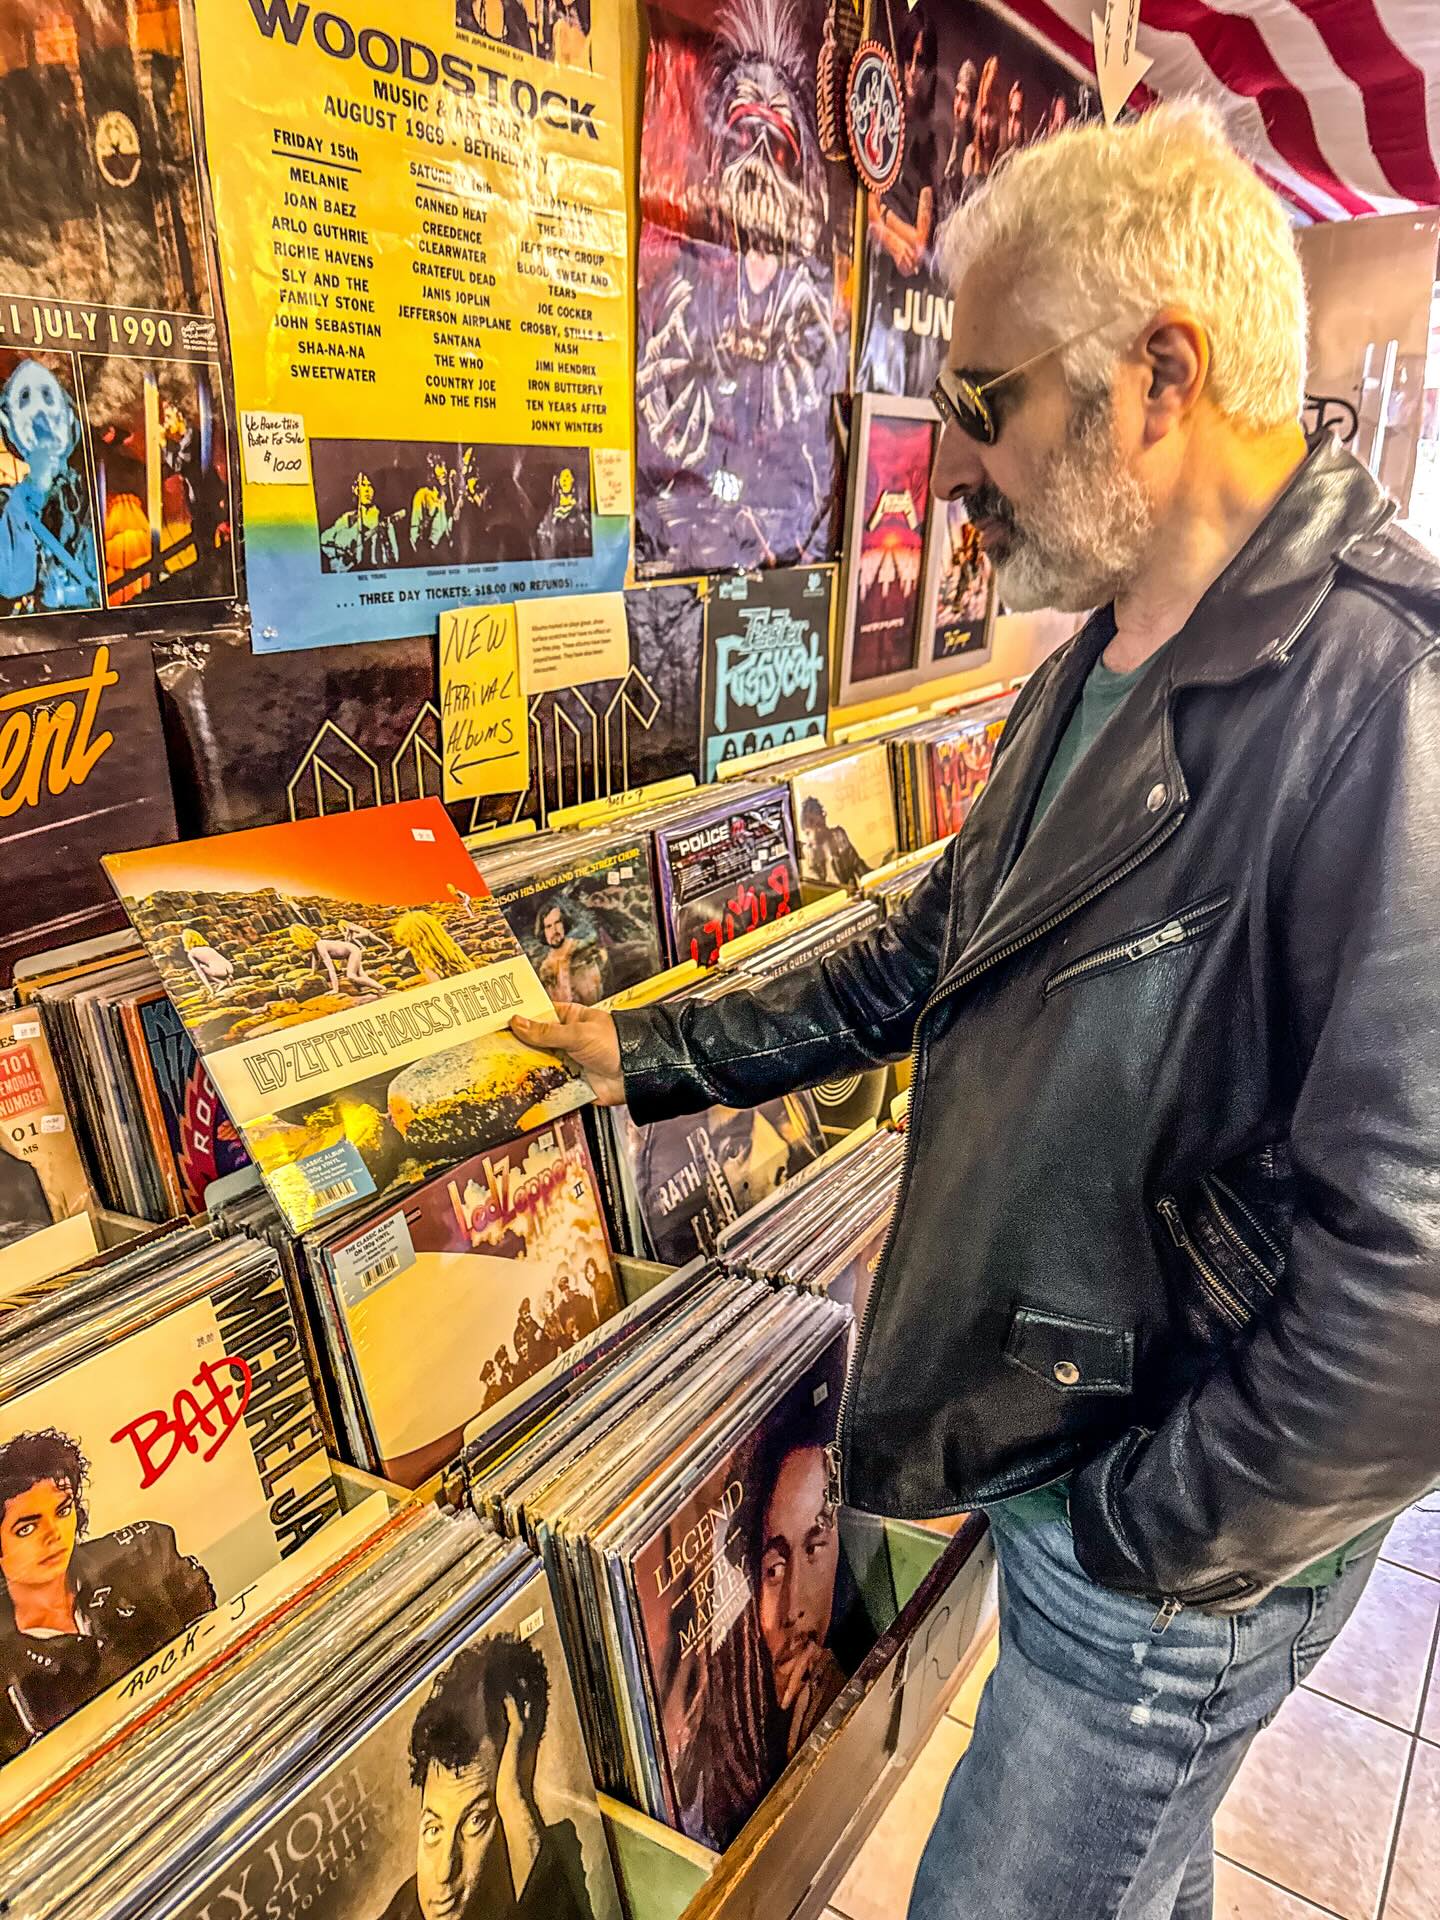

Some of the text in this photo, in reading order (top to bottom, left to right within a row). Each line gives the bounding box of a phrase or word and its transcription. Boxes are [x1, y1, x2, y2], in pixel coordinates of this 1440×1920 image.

[248, 0, 599, 140] WOODSTOCK
[324, 95, 398, 132] AUGUST
[405, 118, 445, 146] 1969
[373, 79, 429, 113] MUSIC
[436, 100, 448, 118] &
[489, 118, 521, 144] FAIR
[273, 128, 360, 162] FRIDAY 15th
[289, 166, 349, 192] MELANIE
[409, 161, 492, 195] SATURDAY 16th
[283, 191, 357, 218] JOAN BAEZ
[415, 195, 488, 223] CANNED HEAT
[272, 216, 369, 246] ARLO GUTHRIE
[422, 220, 483, 245] CREEDENCE
[537, 222, 557, 238] THE
[273, 241, 375, 269] RICHIE HAVENS
[418, 239, 487, 264] CLEARWATER
[575, 250, 605, 266] GROUP
[282, 268, 370, 293] SLY AND THE
[412, 261, 497, 287] GRATEFUL DEAD
[556, 267, 587, 284] SWEAT
[590, 273, 609, 288] AND
[280, 289, 375, 314] FAMILY STONE
[422, 285, 491, 308] JANIS JOPLIN
[548, 285, 577, 300] TEARS
[398, 304, 512, 331] JEFFERSON AIRPLANE
[538, 303, 593, 321] JOE COCKER
[32, 306, 98, 346] JULY
[109, 315, 173, 347] 1990
[275, 313, 382, 339] JOHN SEBASTIAN
[520, 321, 561, 339] CROSBY,
[564, 327, 594, 341] STILLS
[298, 340, 366, 361] SHA-NA-NA
[433, 331, 481, 349] SANTANA
[554, 342, 579, 356] NASH
[290, 364, 377, 384] SWEETWATER
[434, 353, 484, 370] THE WHO
[535, 360, 597, 377] JIMI HENDRIX
[425, 375, 496, 392] COUNTRY JOE
[528, 379, 603, 397] IRON BUTTERFLY
[424, 392, 497, 409] AND THE FISH
[526, 399, 607, 416] TEN YEARS AFTER
[531, 420, 604, 434] JONNY WINTERS
[359, 579, 573, 606] THREE DAY TICKETS: $18.00 (NO REFUNDS)
[444, 613, 508, 666] NEW
[669, 844, 680, 852] THE
[679, 824, 730, 856] POLICE
[520, 887, 535, 899] HIS
[535, 877, 558, 893] BAND
[557, 871, 574, 884] AND
[574, 866, 592, 879] THE
[589, 856, 618, 874] STREET
[617, 847, 641, 863] CHOIR
[789, 949, 813, 970] QUEEN
[813, 938, 836, 956] QUEEN
[835, 925, 857, 943] QUEEN
[856, 913, 878, 932] QUEEN
[322, 1157, 341, 1169] VINYL
[324, 1147, 345, 1161] ALBUM
[345, 1219, 395, 1256] THE CLASSIC ALBUM
[353, 1247, 363, 1258] ON
[375, 1230, 391, 1243] VINYL
[209, 1272, 326, 1502] MICHAEL
[110, 1356, 253, 1490] BAD
[652, 1480, 745, 1599] LEGEND
[692, 1554, 730, 1610] BOB
[678, 1553, 746, 1652] MARLEY
[264, 1766, 381, 1893] JOEL
[315, 1798, 389, 1876] HITS
